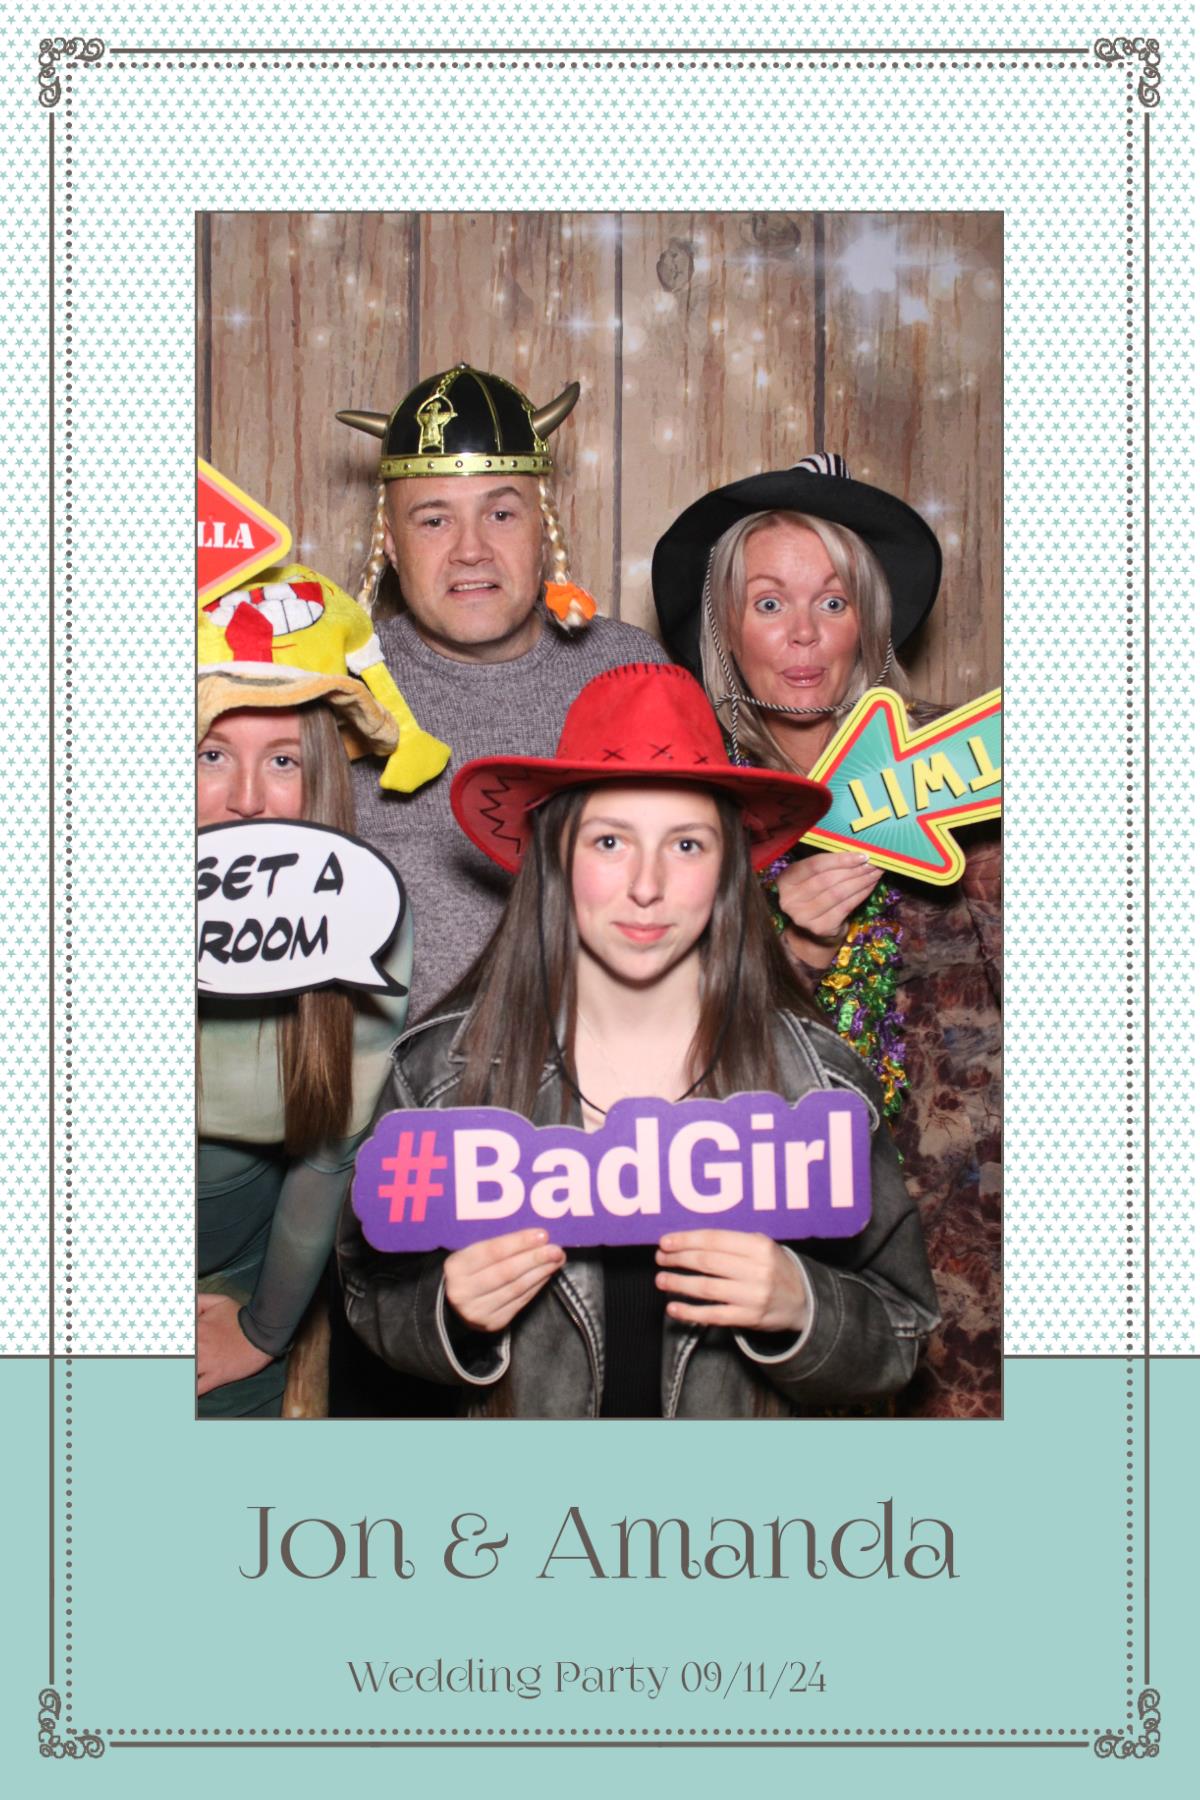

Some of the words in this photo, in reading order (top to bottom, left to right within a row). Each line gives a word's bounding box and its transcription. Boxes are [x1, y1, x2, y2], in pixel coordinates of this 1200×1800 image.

[849, 736, 1001, 833] TWIT
[198, 854, 299, 901] GET
[314, 852, 344, 895] A
[199, 915, 328, 963] ROOM
[378, 1111, 854, 1223] #BadGirl
